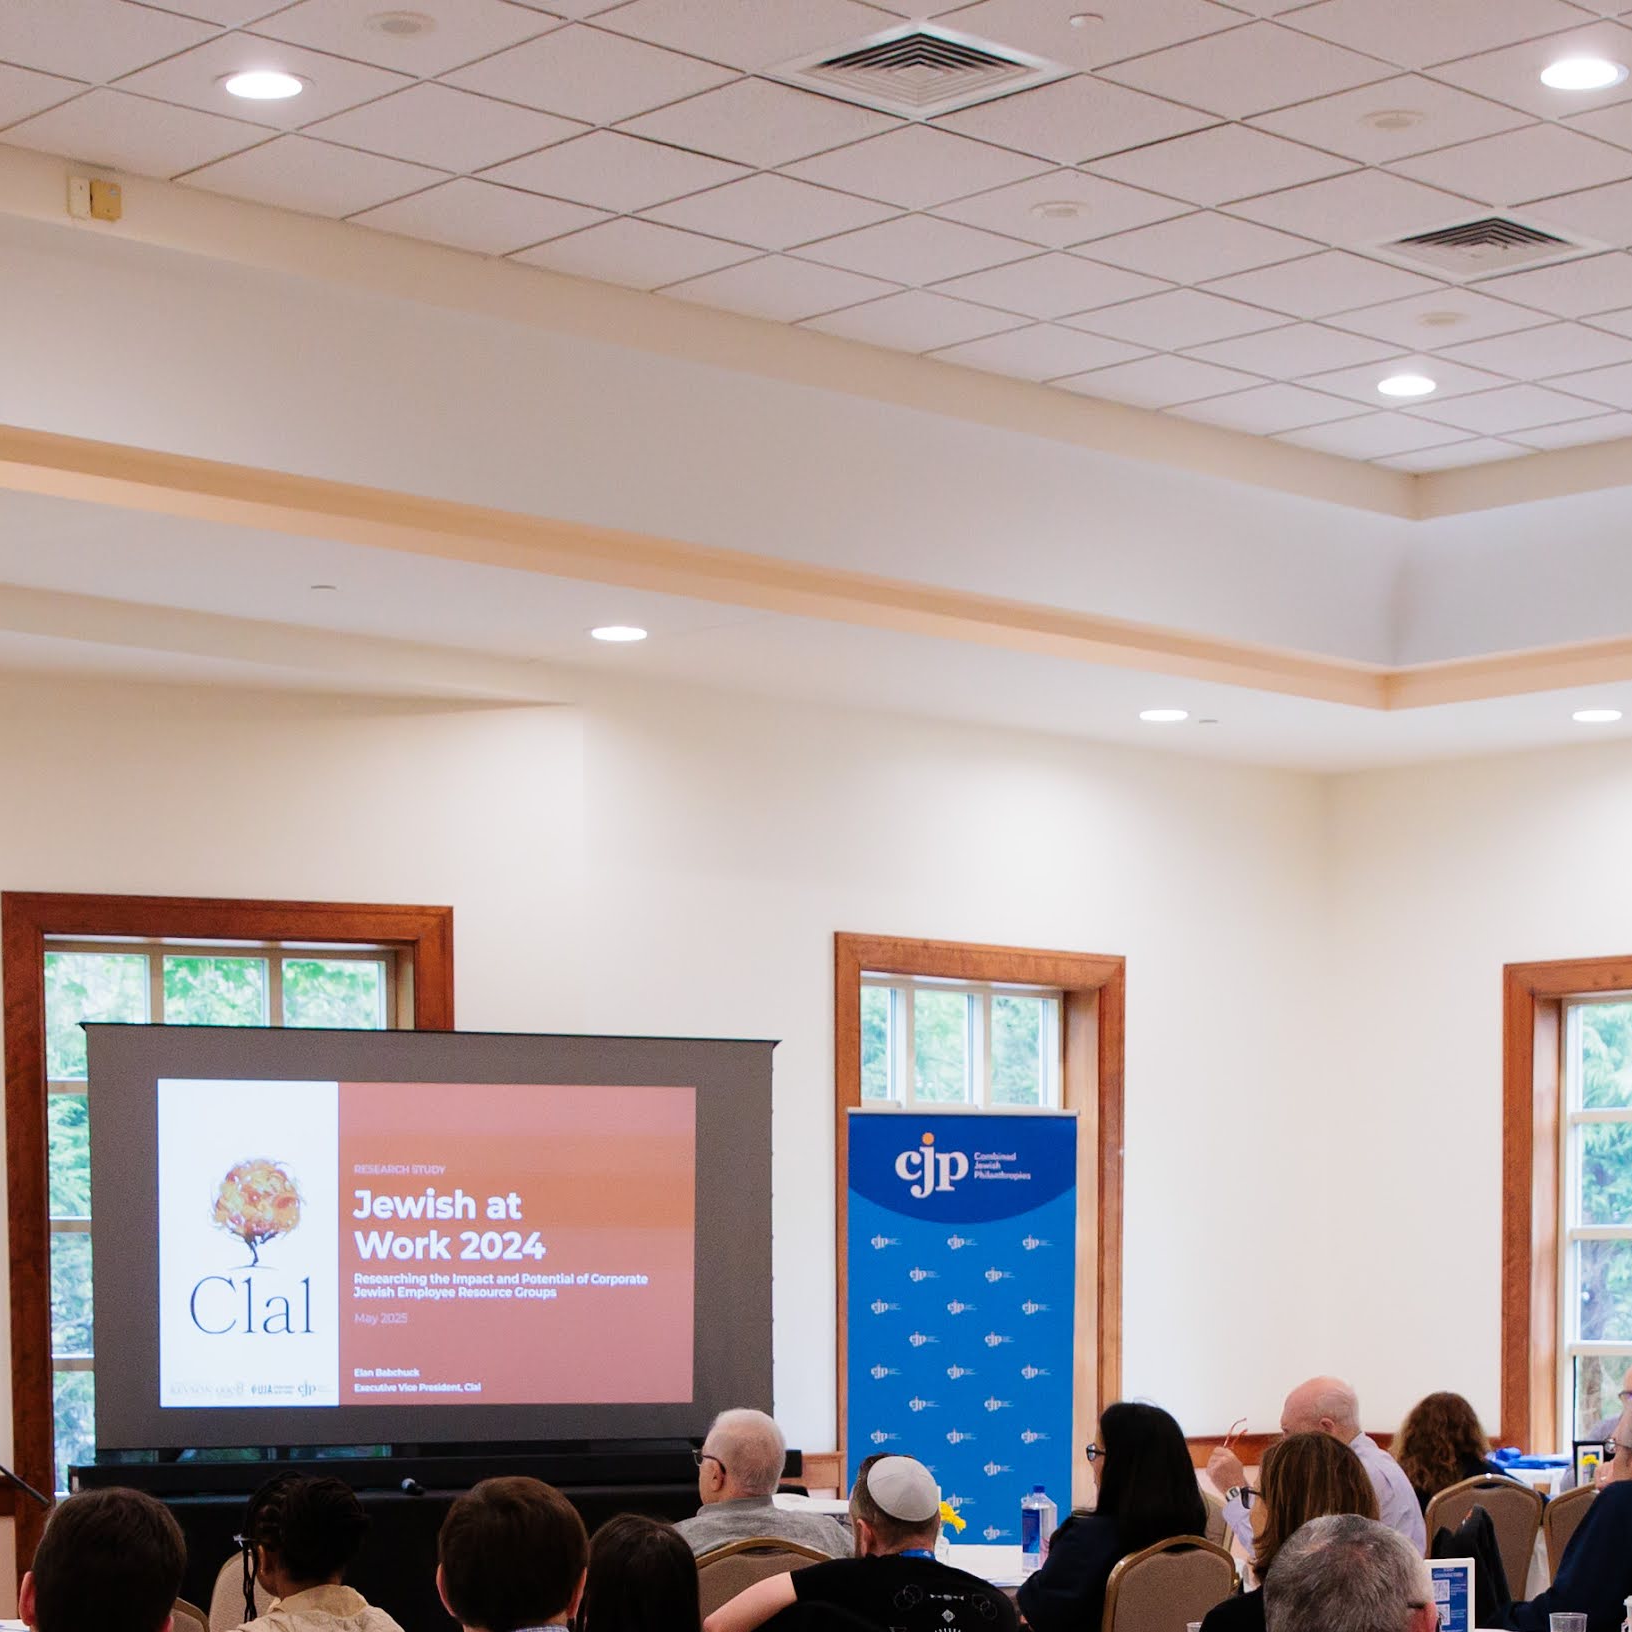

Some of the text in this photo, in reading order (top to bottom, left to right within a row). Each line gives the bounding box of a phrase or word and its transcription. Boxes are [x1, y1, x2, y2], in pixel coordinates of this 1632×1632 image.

[974, 1152, 1017, 1161] Combined
[354, 1163, 446, 1175] RESEARCH STUDY
[894, 1132, 969, 1199] cjp
[974, 1161, 1001, 1170] Jewish
[974, 1170, 1031, 1181] Philanthropies
[353, 1187, 523, 1220] Jewish at
[354, 1229, 547, 1260] Work 2024
[353, 1273, 649, 1287] Researching the Impact and Potential of Corporate
[353, 1286, 557, 1300] Jewish Employee Resource Groups
[189, 1275, 315, 1336] Clal
[354, 1312, 408, 1326] May 2025
[354, 1383, 397, 1393] Executive
[398, 1383, 417, 1393] Vice
